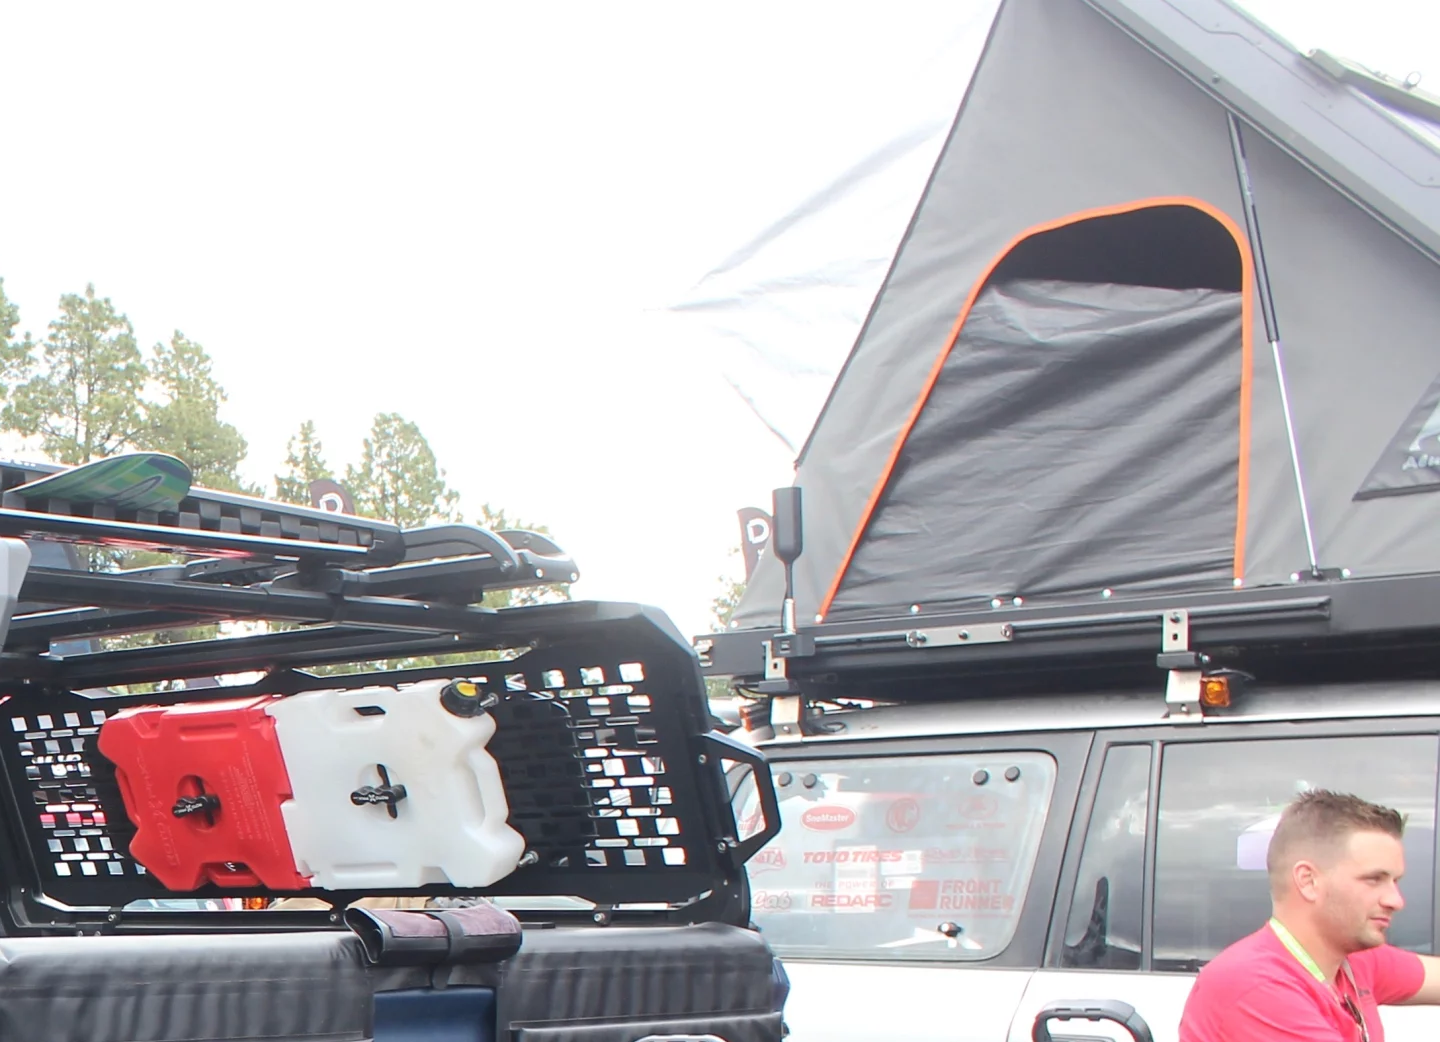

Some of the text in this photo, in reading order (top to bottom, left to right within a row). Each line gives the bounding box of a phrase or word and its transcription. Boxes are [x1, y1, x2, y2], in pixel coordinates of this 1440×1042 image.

[747, 517, 770, 544] D
[803, 850, 903, 863] TOYO TIRES
[941, 879, 1003, 894] FRONT
[811, 894, 893, 908] REDARC
[940, 894, 1016, 910] RUNNER
